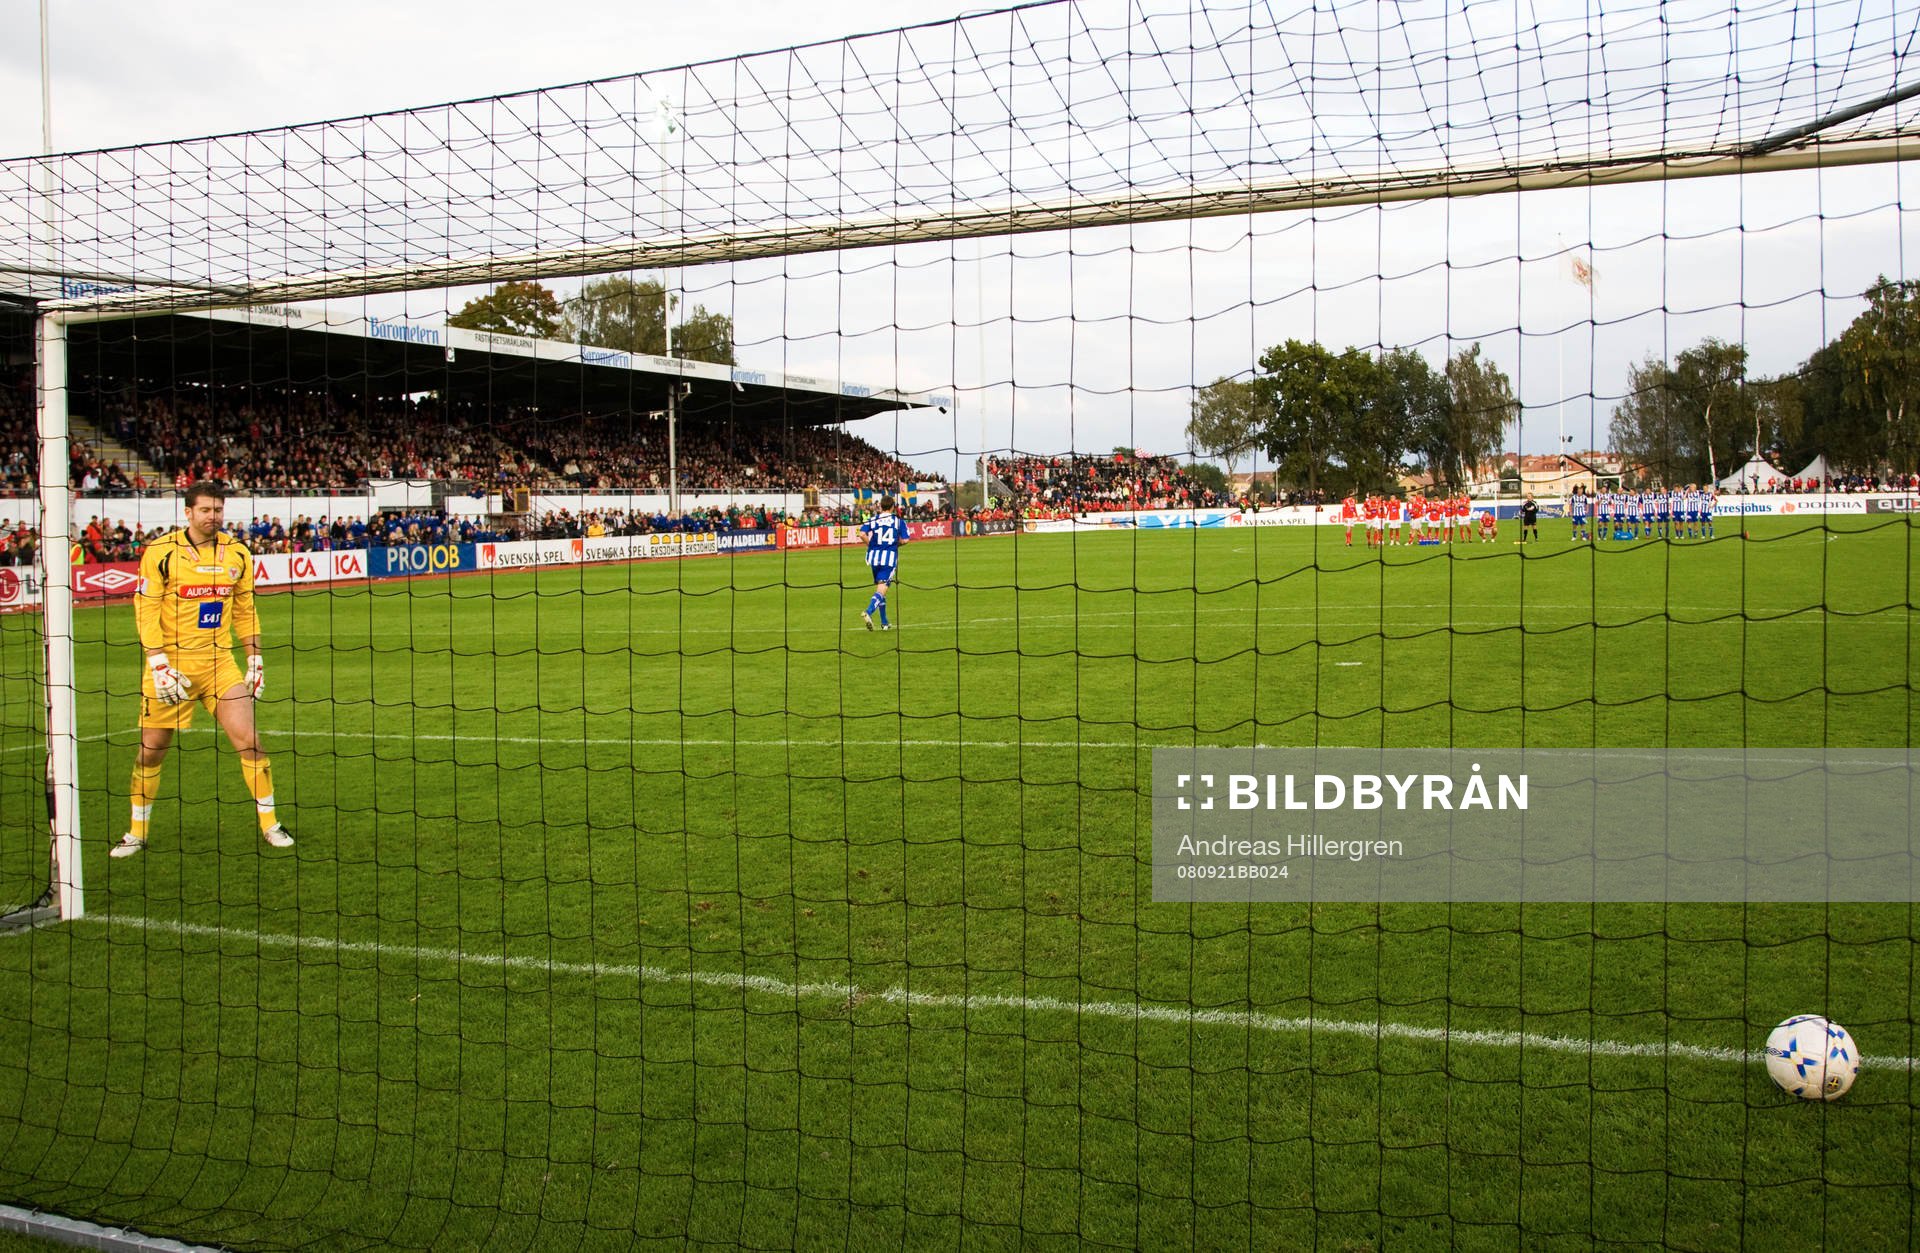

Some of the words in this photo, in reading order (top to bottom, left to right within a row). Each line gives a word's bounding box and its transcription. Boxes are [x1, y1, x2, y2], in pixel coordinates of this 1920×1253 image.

[370, 316, 439, 344] Barometern
[717, 534, 776, 549] LOKALDELEN.SE
[786, 527, 820, 545] GEVALIA
[874, 527, 895, 545] 14
[387, 544, 460, 572] PROJOB
[499, 552, 540, 566] SVENSKA
[544, 550, 565, 562] SPEL
[586, 547, 625, 560] SVENSKA
[628, 545, 647, 557] SPEL
[288, 557, 317, 579] ICA
[335, 555, 361, 575] ICA
[215, 586, 235, 595] VIDE
[200, 613, 222, 623] SAS
